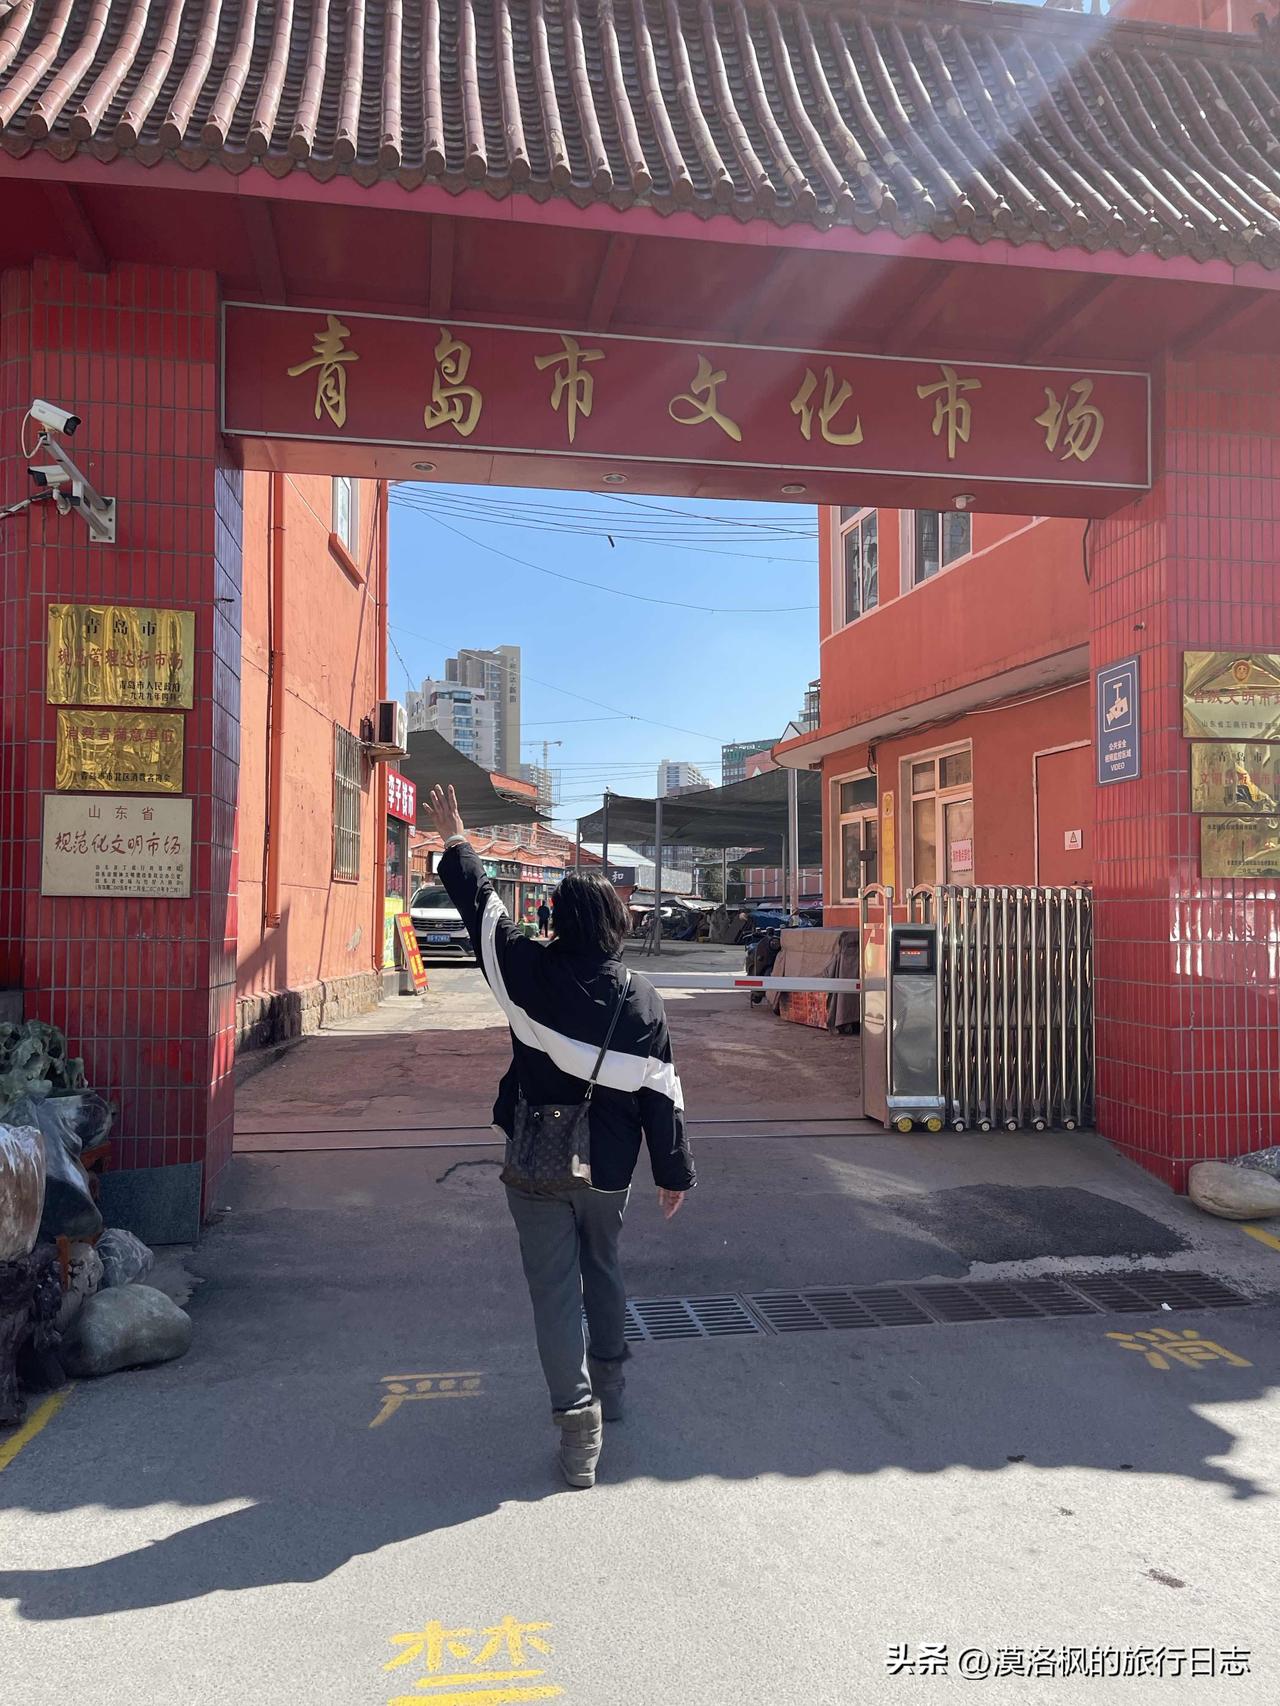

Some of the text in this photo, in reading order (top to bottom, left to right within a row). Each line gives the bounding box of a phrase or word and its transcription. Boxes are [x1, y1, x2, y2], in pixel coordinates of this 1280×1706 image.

[288, 314, 1104, 462] 青岛市文化市场
[87, 618, 157, 637] 青岛市
[119, 680, 181, 693] 青岛市人民政府
[66, 726, 175, 743] 消费者满意单位
[1110, 761, 1126, 772] VIDEO
[88, 804, 155, 821] 山东省
[55, 829, 182, 857] 规范化文明市场
